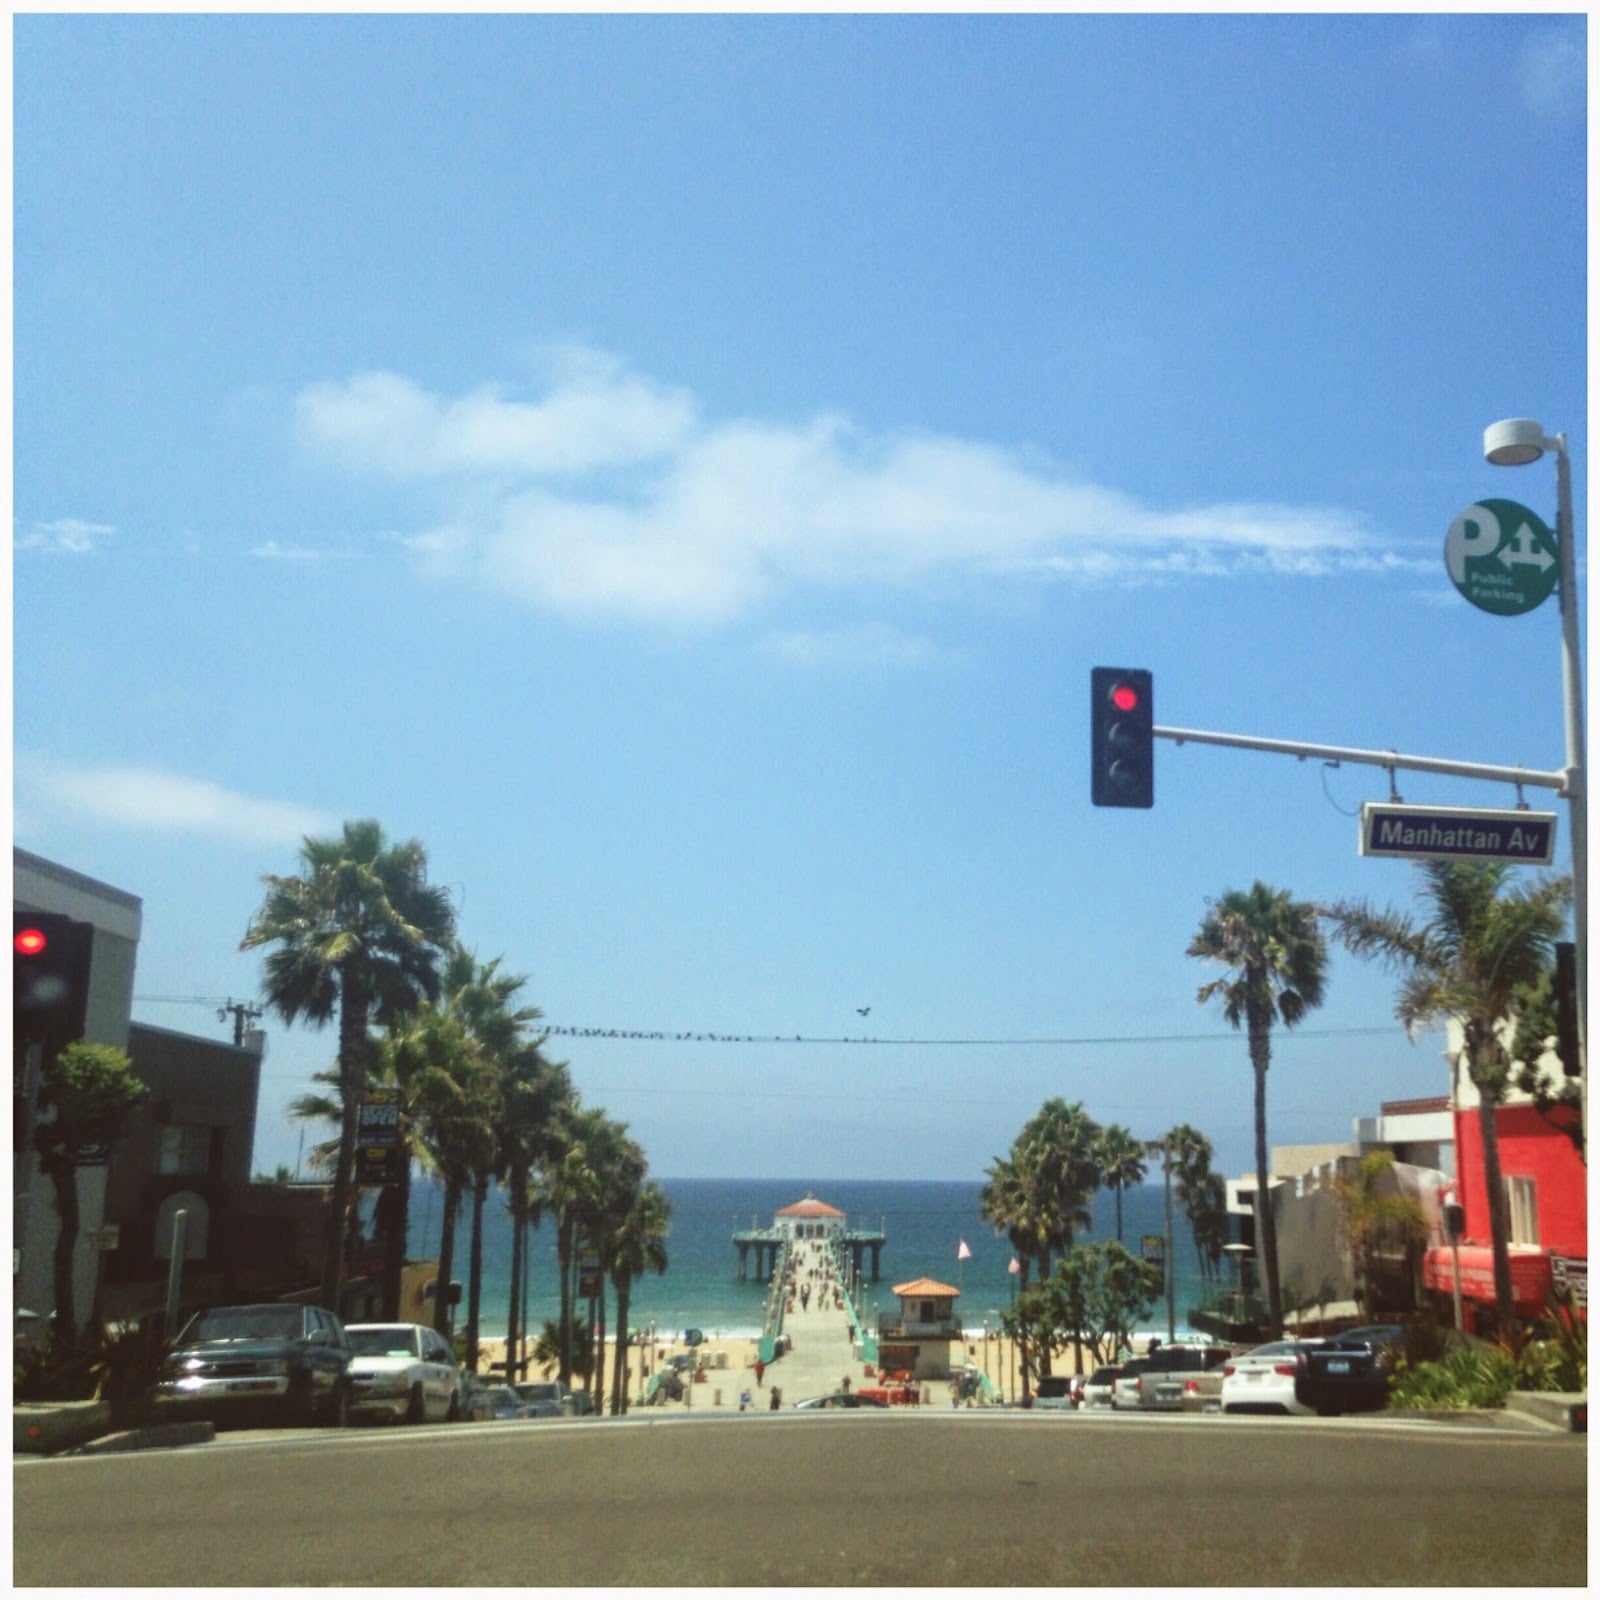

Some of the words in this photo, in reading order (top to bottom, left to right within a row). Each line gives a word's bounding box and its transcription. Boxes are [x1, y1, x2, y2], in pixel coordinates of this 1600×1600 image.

[1444, 504, 1501, 583] P
[1471, 572, 1513, 585] Public
[1471, 587, 1525, 603] Parking
[1379, 819, 1500, 849] Manhattan
[1507, 826, 1540, 851] Av
